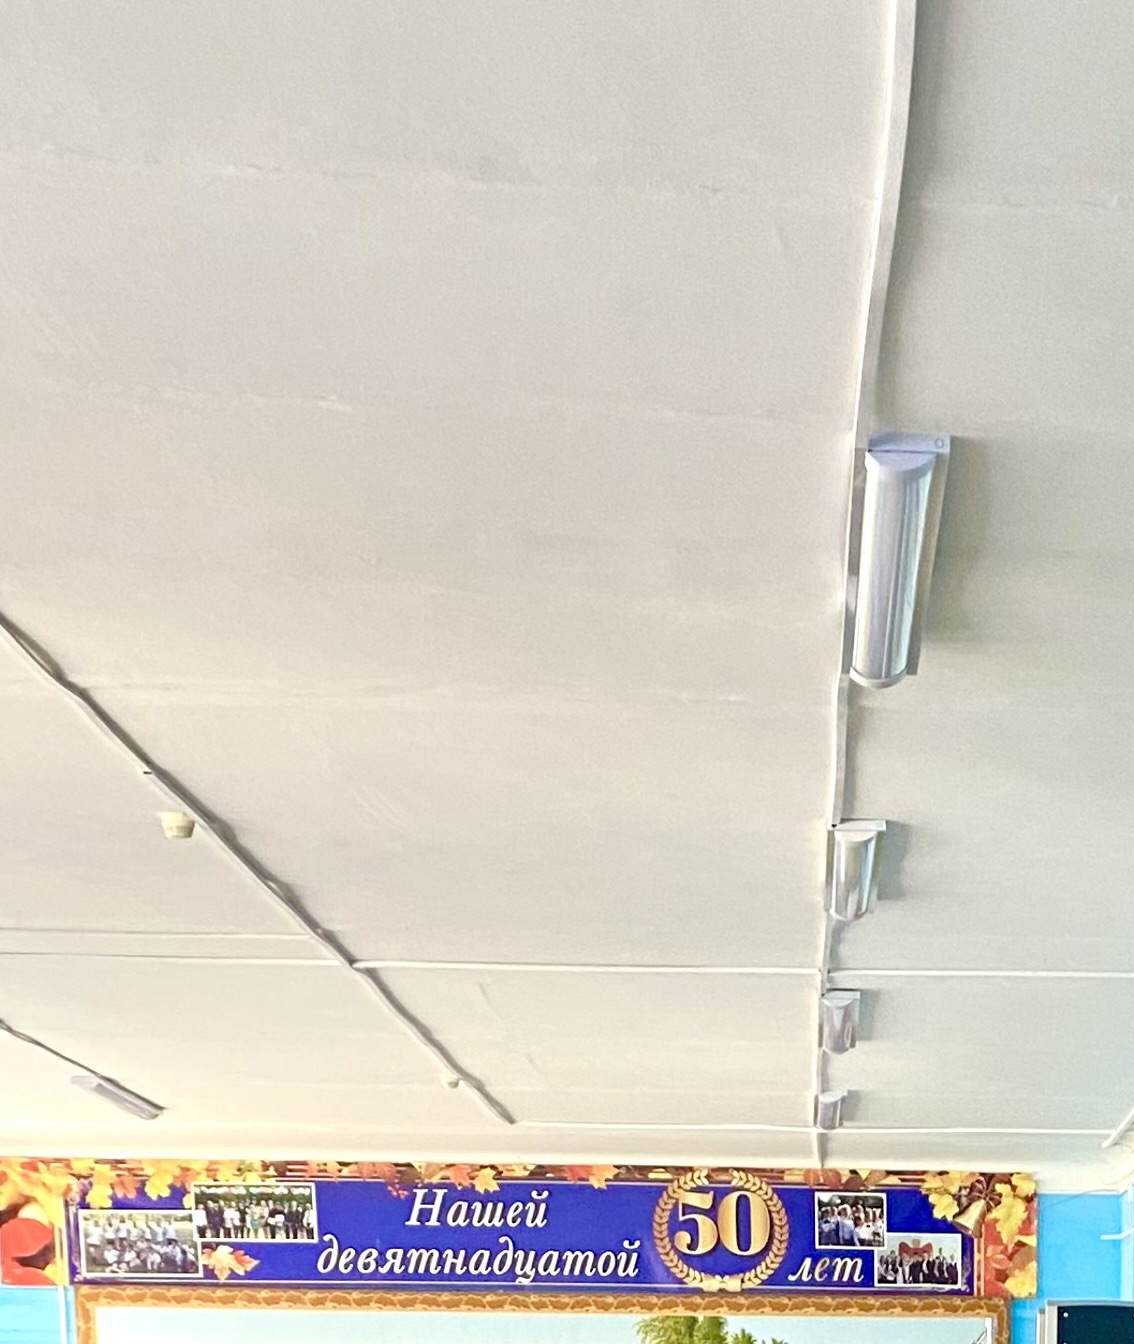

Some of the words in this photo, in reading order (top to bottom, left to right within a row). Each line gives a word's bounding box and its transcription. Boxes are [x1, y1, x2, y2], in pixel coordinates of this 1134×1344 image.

[406, 1188, 549, 1228] Нашей
[674, 1189, 771, 1256] 50
[317, 1234, 640, 1284] девятнадцатой
[788, 1257, 865, 1283] лет
